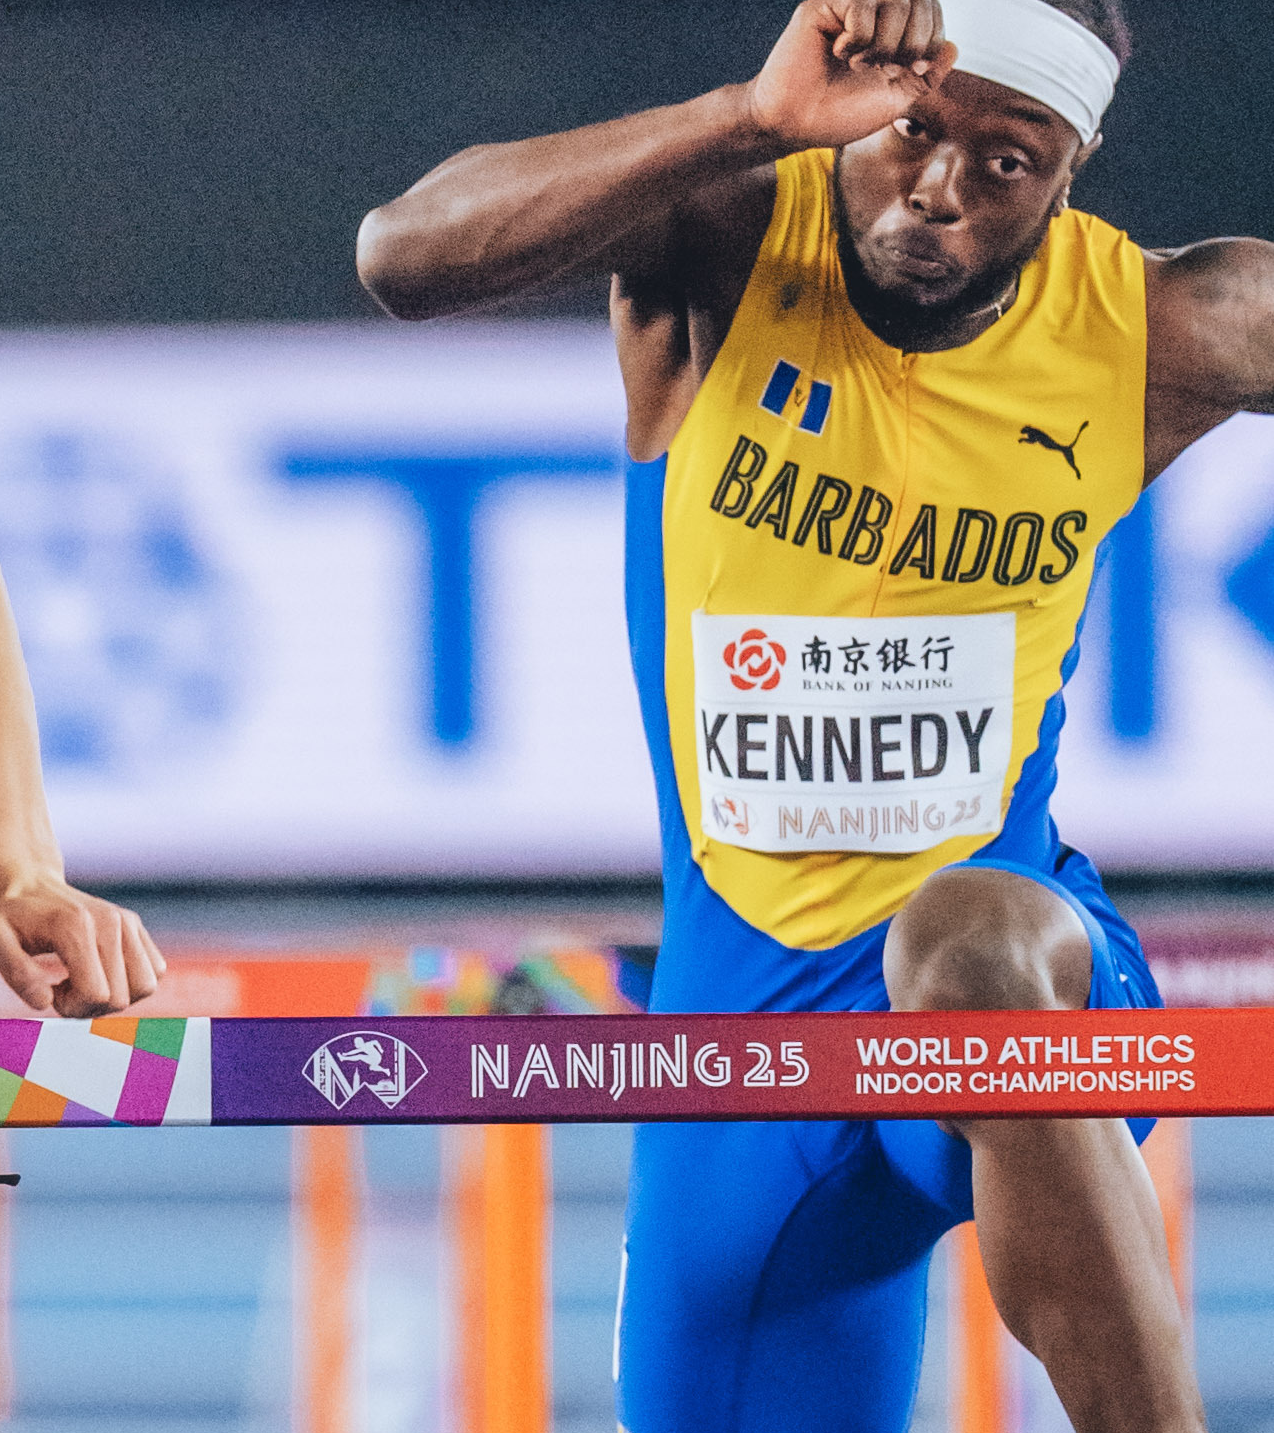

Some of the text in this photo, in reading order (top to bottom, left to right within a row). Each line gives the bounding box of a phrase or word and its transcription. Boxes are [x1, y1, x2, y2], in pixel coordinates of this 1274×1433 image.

[709, 433, 1088, 587] BARBADOS
[801, 635, 955, 676] 南京银行
[802, 677, 952, 692] BANK OF NANJING
[701, 707, 994, 783] KENNEDY
[778, 799, 946, 843] NANJING
[470, 1034, 811, 1102] NANJING 25
[855, 1034, 1196, 1066] WORLD ATHLETICS
[855, 1068, 1196, 1095] INDOOR CHAMPIONSHIPS
